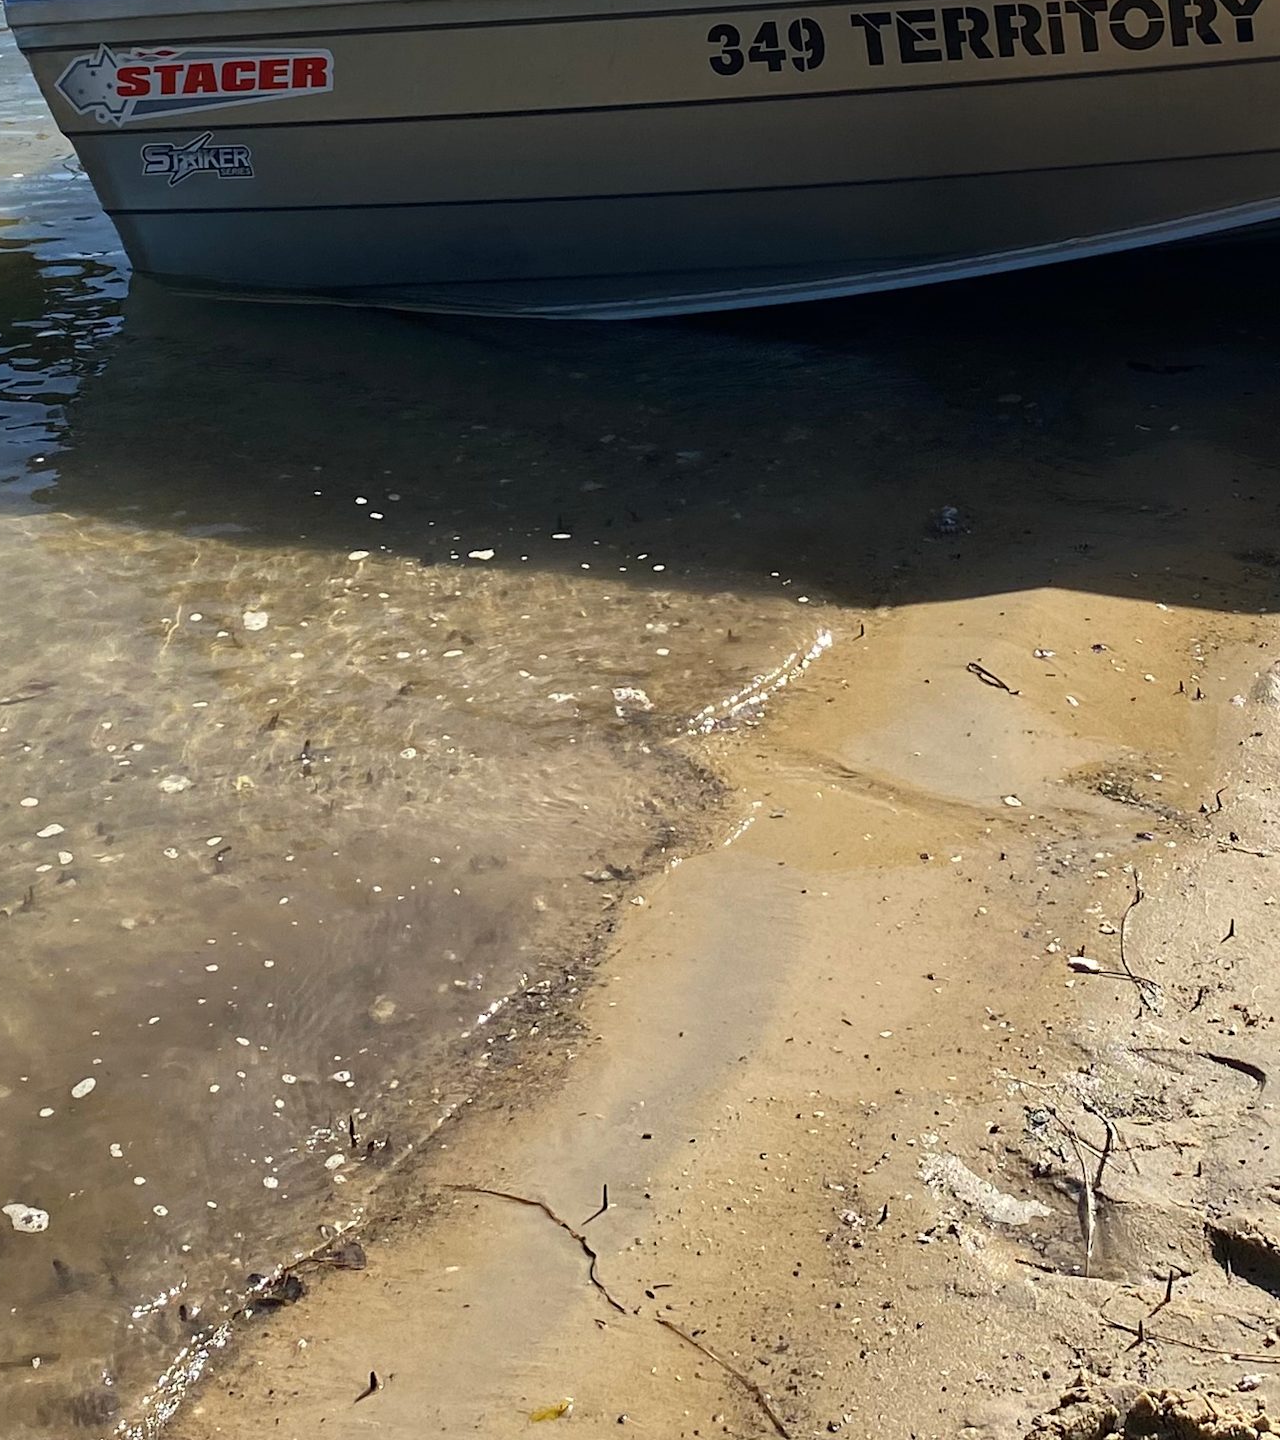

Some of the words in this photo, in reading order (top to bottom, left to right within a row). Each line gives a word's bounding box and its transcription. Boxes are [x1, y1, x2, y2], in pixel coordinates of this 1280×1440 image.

[707, 17, 826, 76] 349
[116, 57, 327, 97] STACER
[143, 145, 250, 172] STRIKER
[220, 167, 252, 176] SERIES
